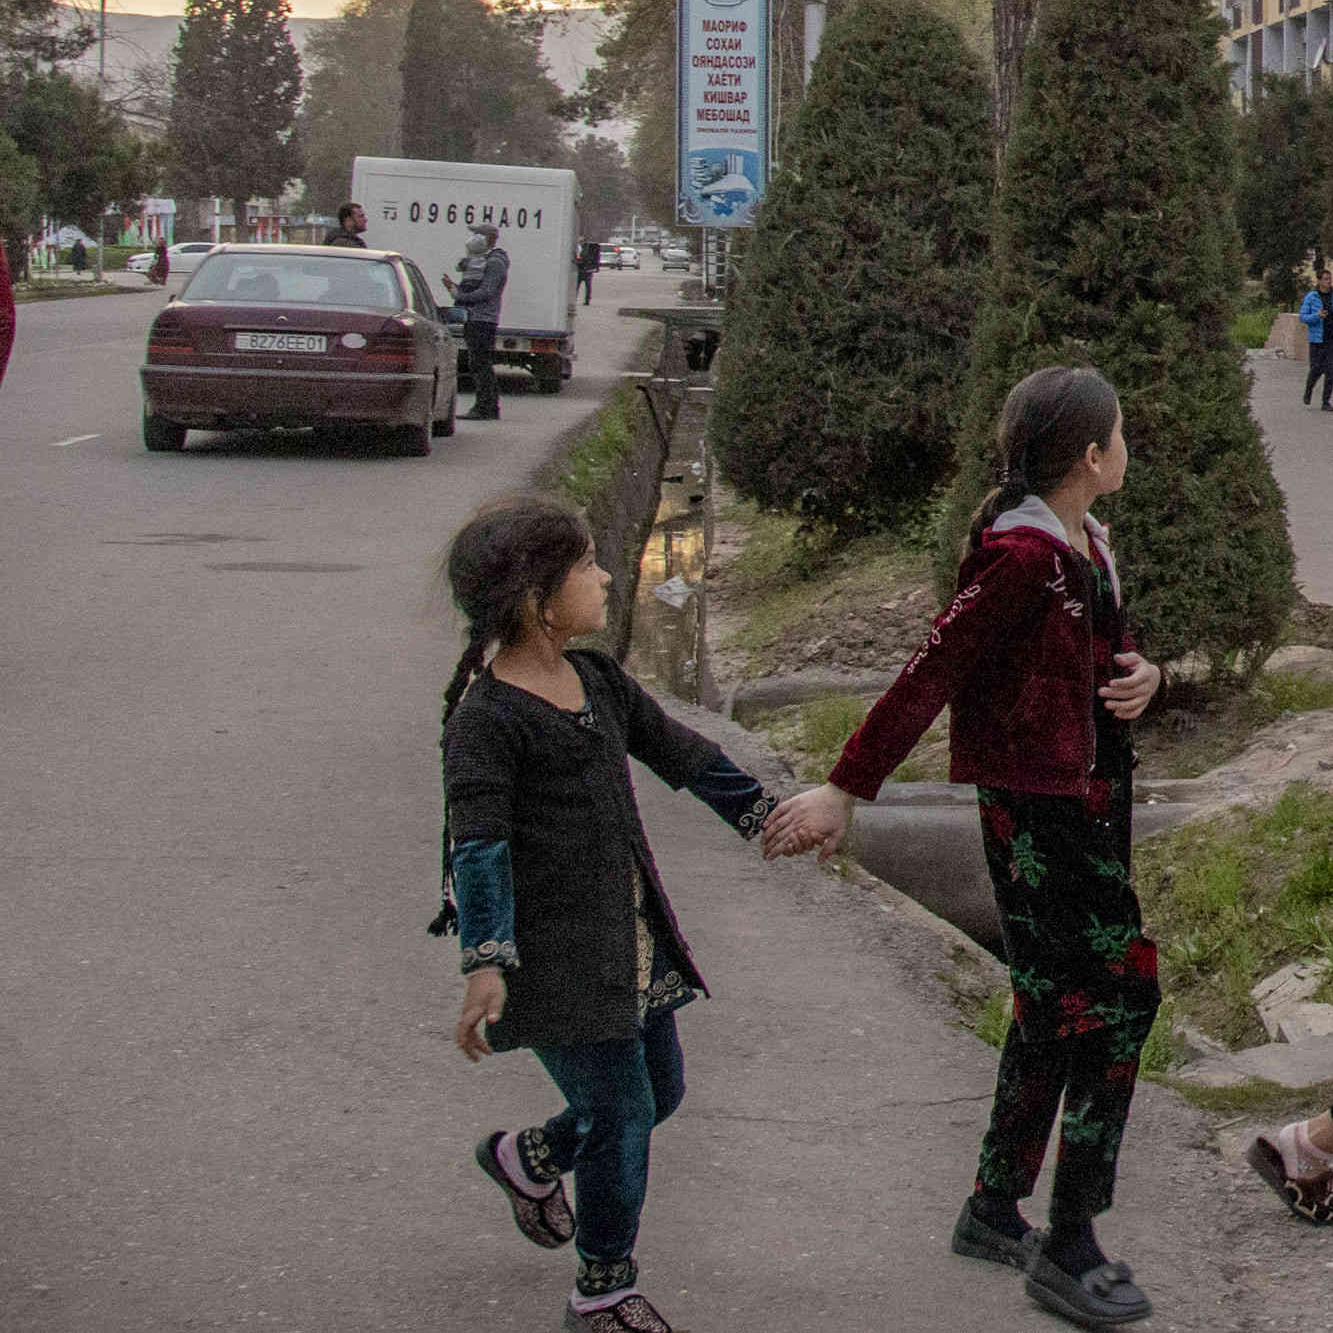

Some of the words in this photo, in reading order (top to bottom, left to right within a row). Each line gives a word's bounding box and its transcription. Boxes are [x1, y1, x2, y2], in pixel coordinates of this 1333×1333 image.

[702, 19, 748, 33] МАОРИФ
[692, 55, 756, 70] ОЯНДАСОЗИ
[704, 90, 748, 104] КИШВАР
[696, 108, 750, 123] МЕБОШАД
[410, 201, 543, 229] 0966HA01
